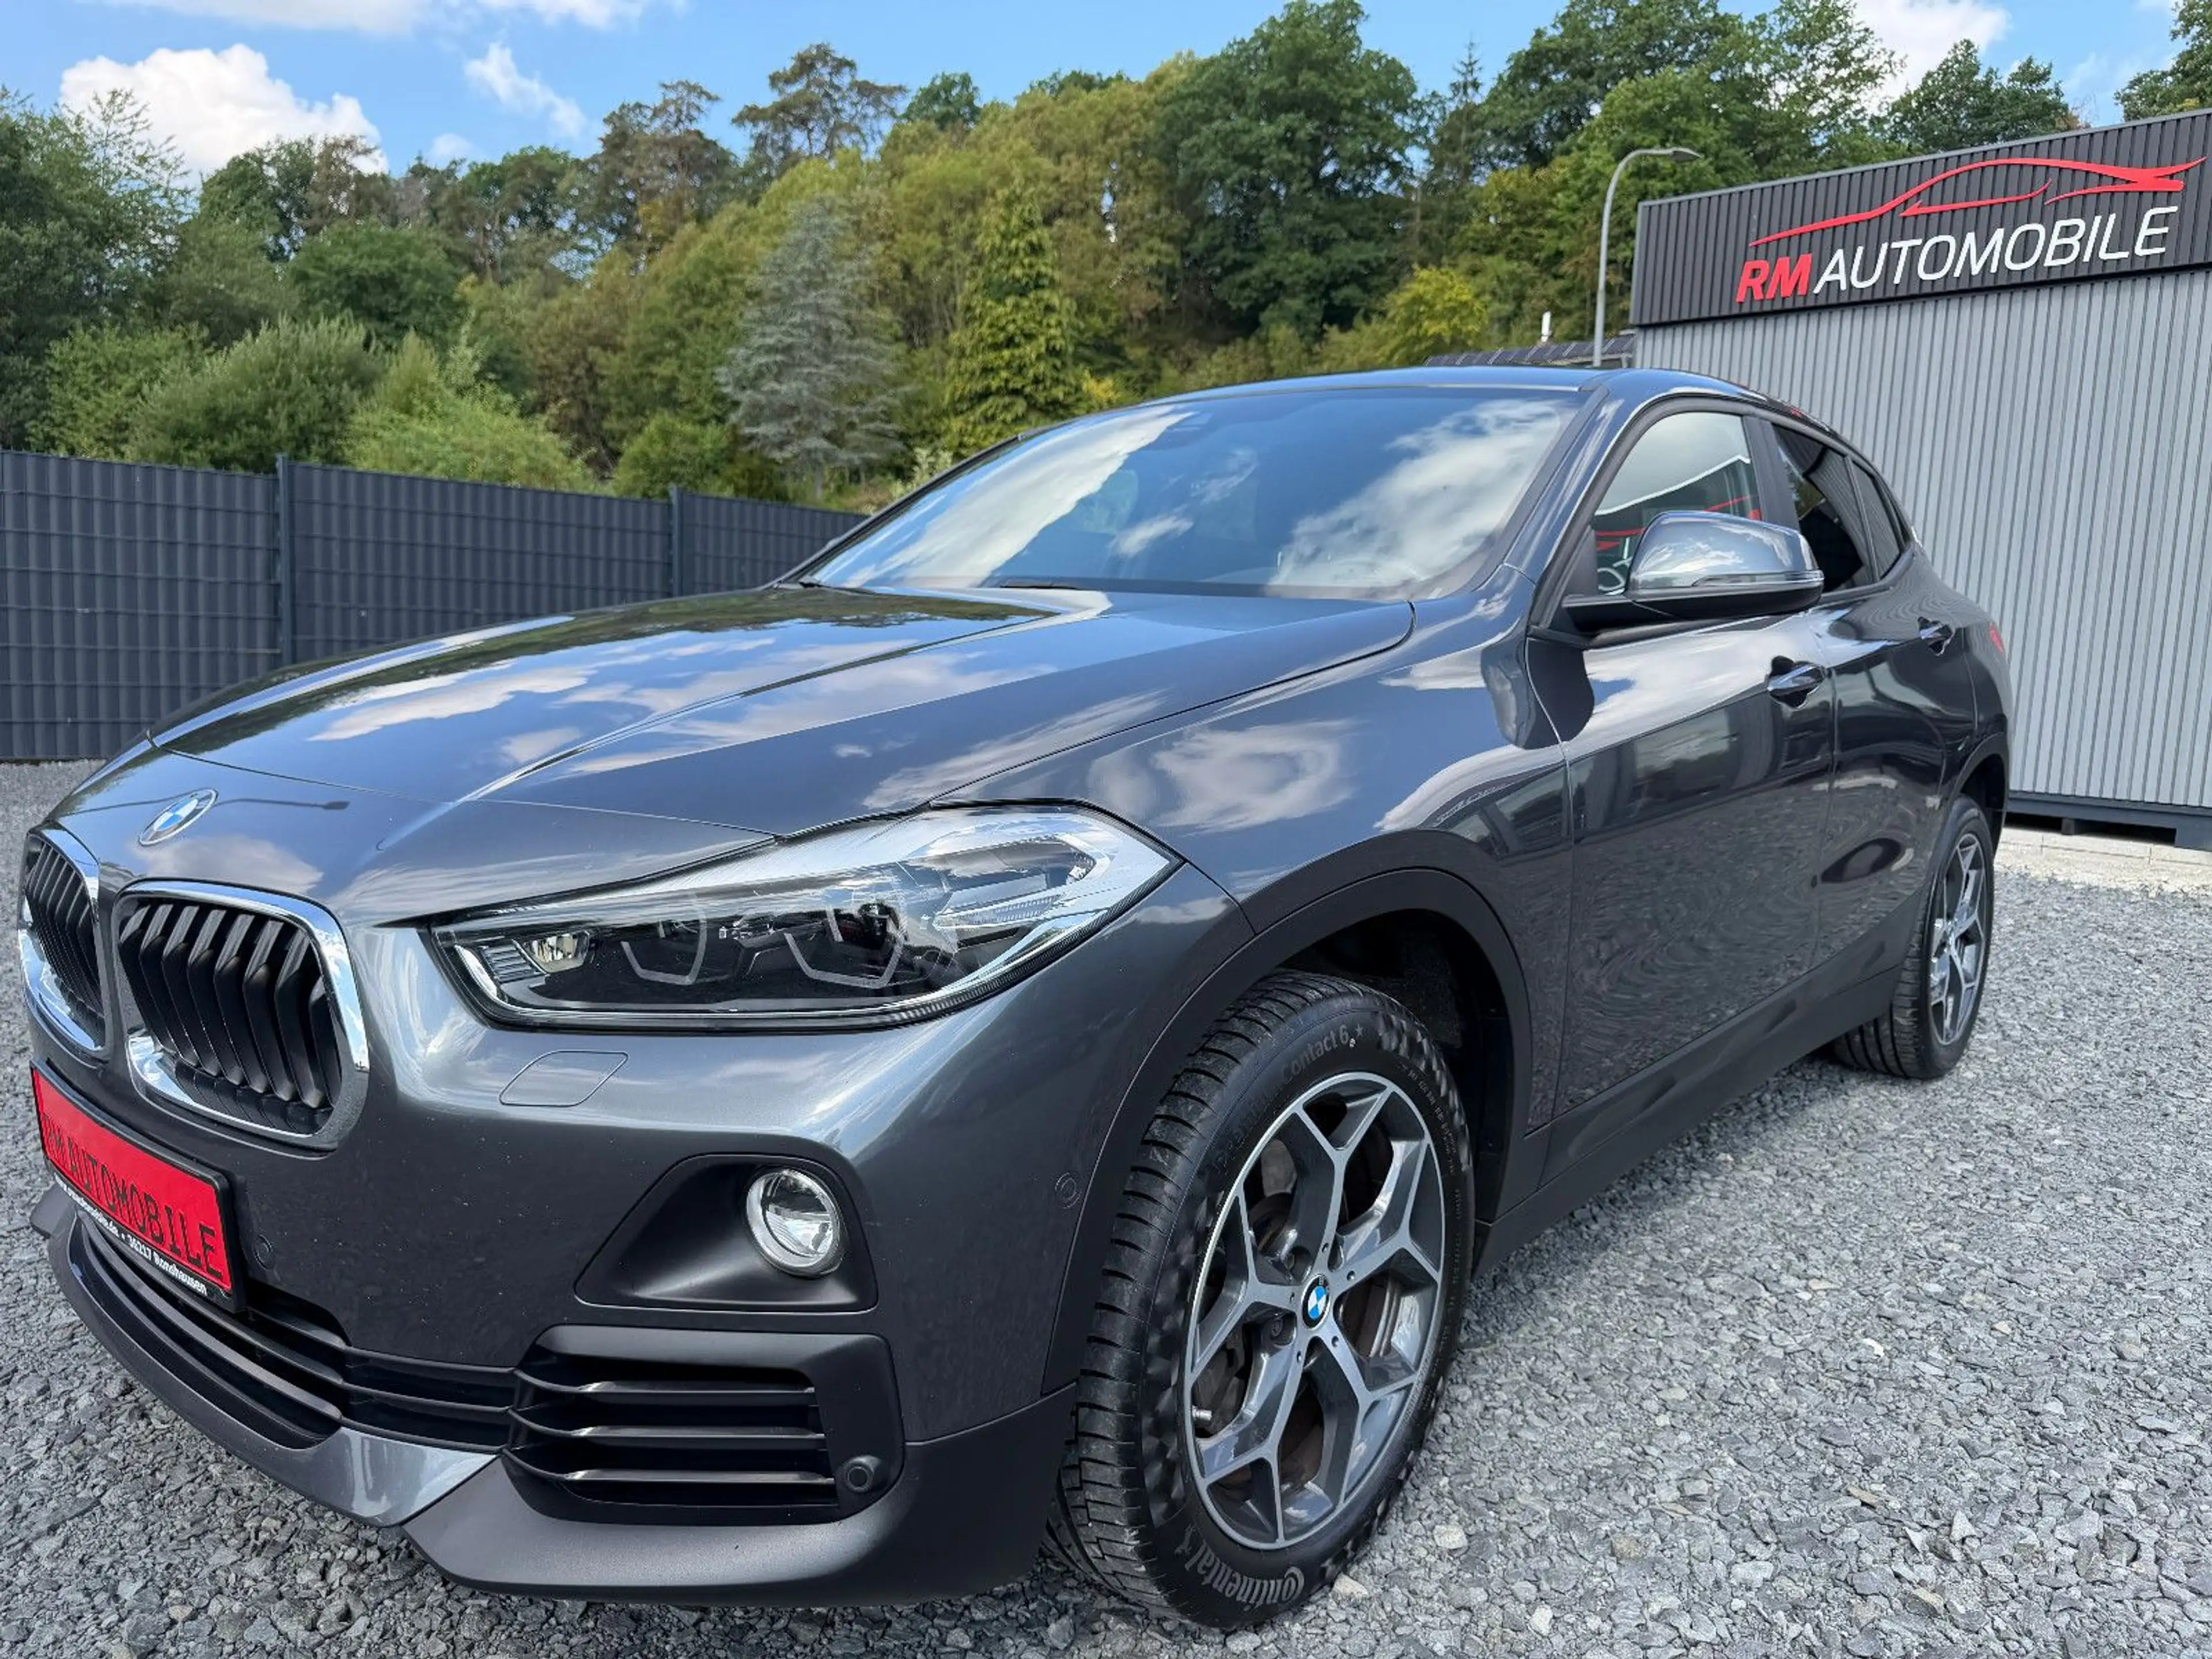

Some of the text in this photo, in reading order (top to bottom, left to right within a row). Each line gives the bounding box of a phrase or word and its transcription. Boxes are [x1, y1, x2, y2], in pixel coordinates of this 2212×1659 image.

[1813, 205, 2179, 294] AUTOMOBILE
[66, 1135, 222, 1279] AUTOMOBILE
[1184, 1539, 1305, 1612] Continental
